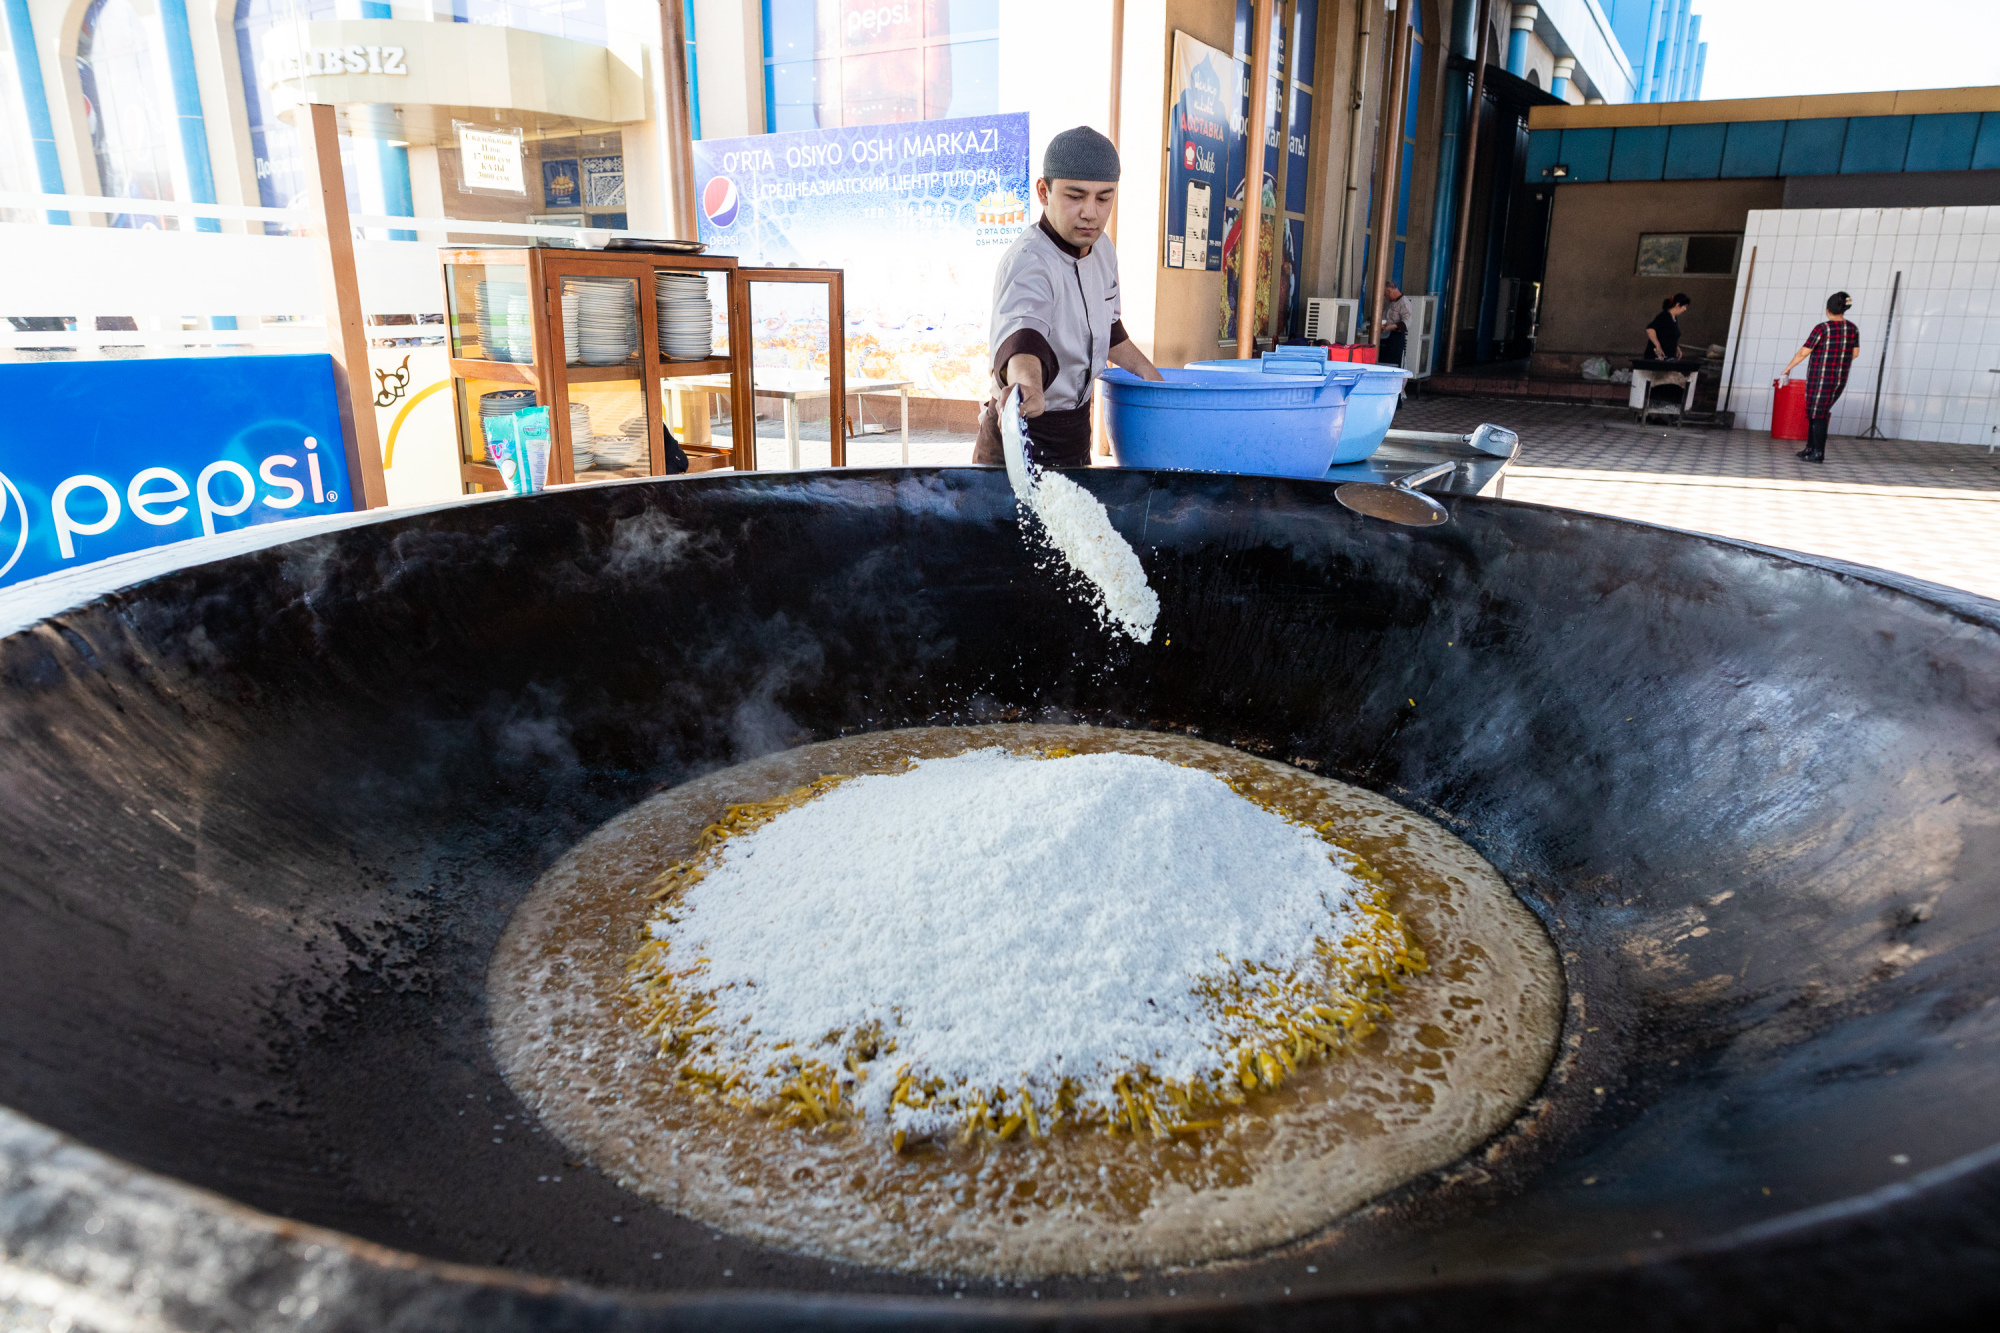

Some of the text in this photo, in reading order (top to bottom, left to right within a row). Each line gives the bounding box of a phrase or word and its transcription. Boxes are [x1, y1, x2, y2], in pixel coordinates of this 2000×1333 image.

[847, 0, 912, 37] pepsi
[1180, 112, 1224, 142] ДОСТАВКА
[786, 143, 843, 169] OSIYO
[851, 137, 893, 163] OSH
[903, 128, 999, 158] MARKAZI
[1195, 145, 1216, 175] Stolik
[761, 169, 998, 200] СРЕДНЕАЗИАТСКИЙ ЦЕНТР ПЛОВА
[708, 233, 739, 248] pepsi
[975, 238, 991, 246] OSH
[1000, 226, 1023, 235] OSIYO
[51, 436, 325, 559] pepsi
